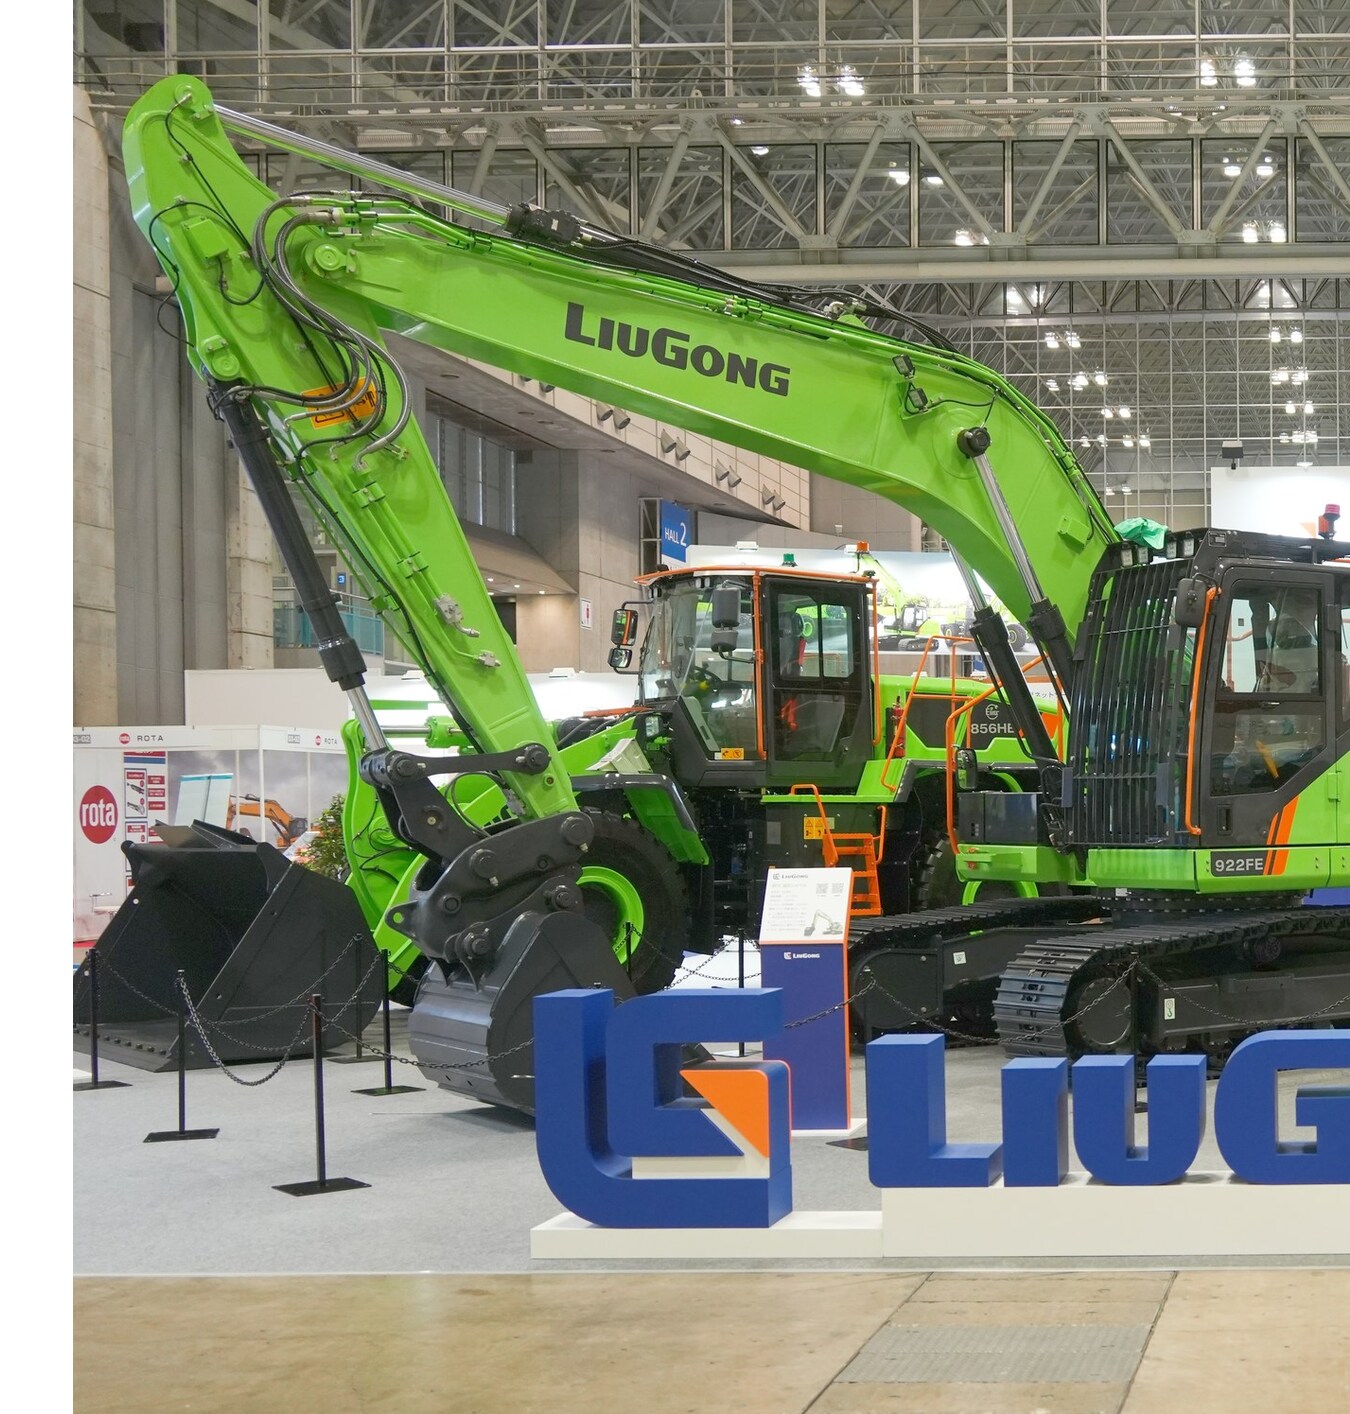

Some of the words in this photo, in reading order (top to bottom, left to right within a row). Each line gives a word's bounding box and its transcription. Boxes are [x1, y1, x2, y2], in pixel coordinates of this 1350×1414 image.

[664, 527, 680, 544] HALL
[680, 522, 687, 547] 2
[971, 722, 1015, 734] 856HE
[81, 798, 116, 827] rota
[1215, 858, 1264, 872] 922FE
